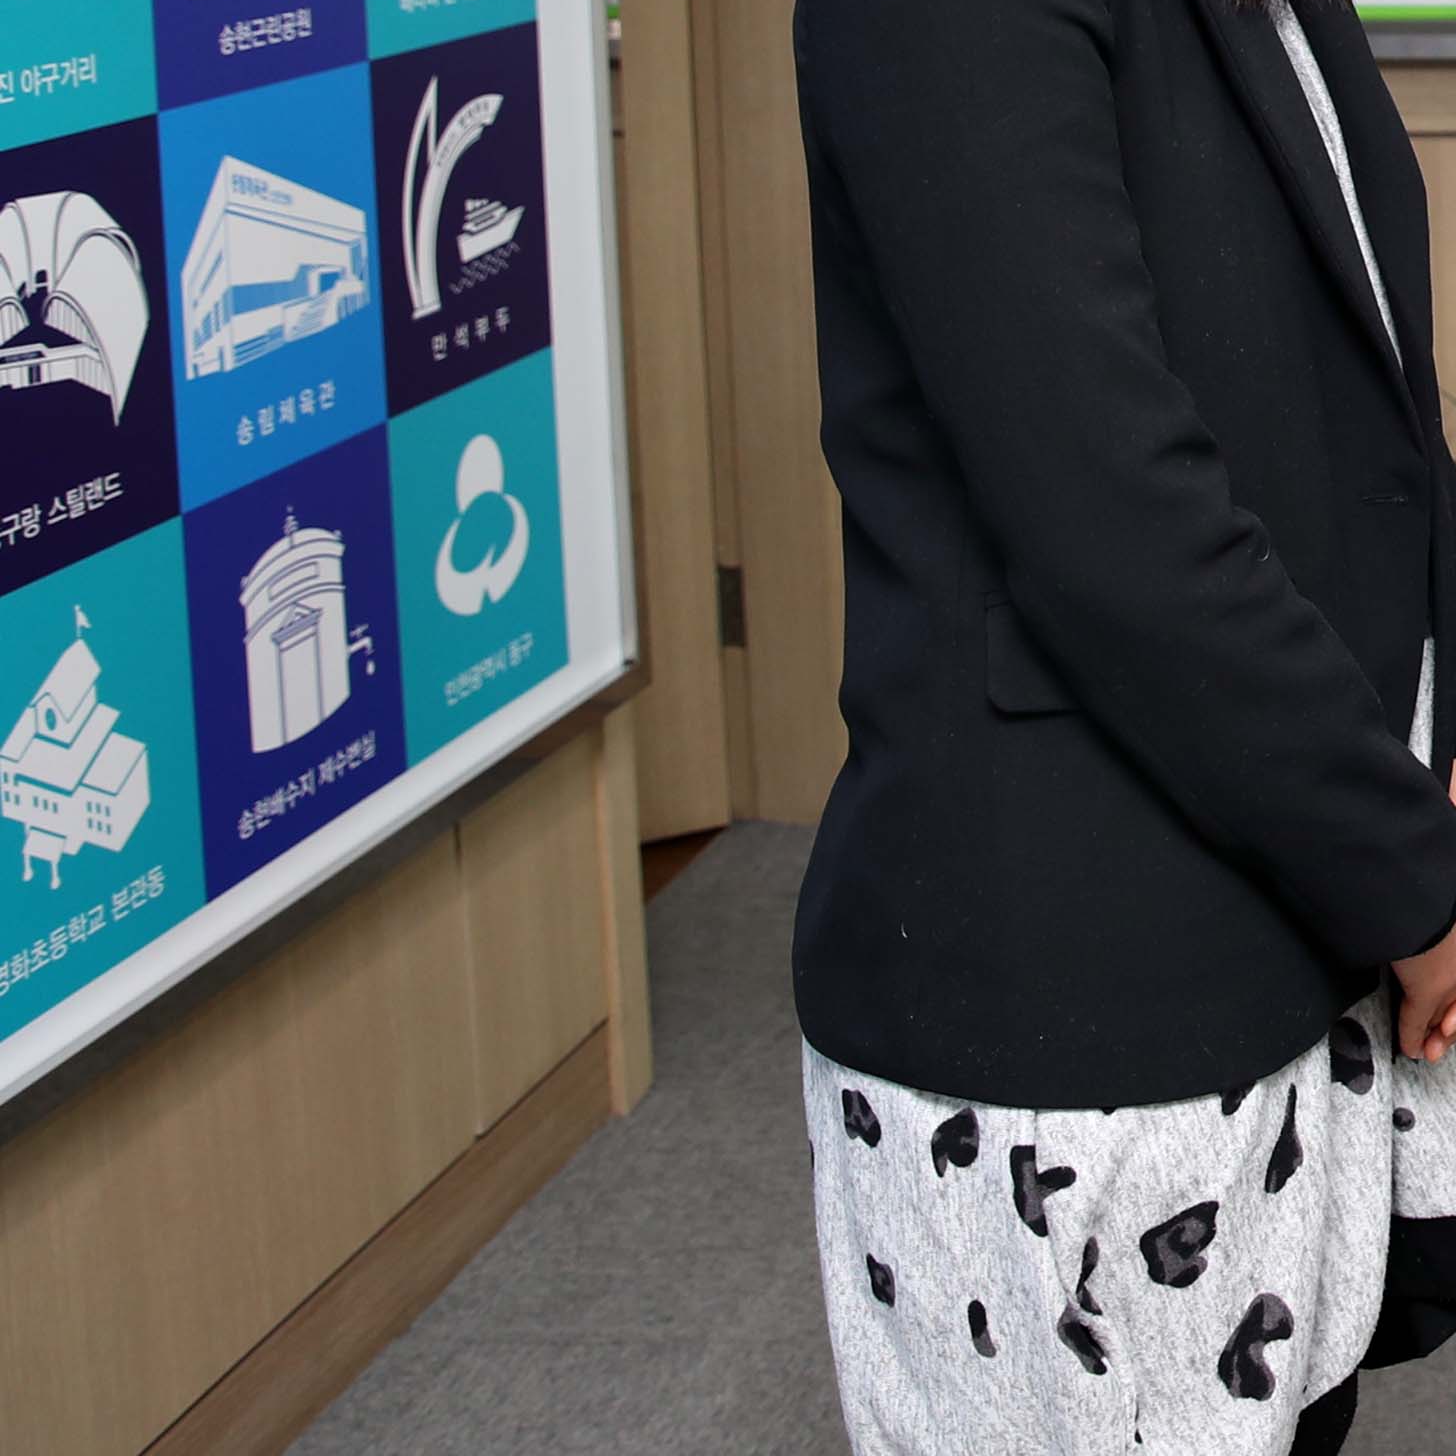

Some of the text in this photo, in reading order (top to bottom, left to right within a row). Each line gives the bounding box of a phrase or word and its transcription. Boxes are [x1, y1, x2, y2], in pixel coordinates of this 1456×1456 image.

[218, 7, 312, 55] 송현근린공원
[20, 53, 97, 97] 야구거리
[0, 472, 125, 549] 구랑 스틸랜드
[111, 864, 166, 922] 본관동
